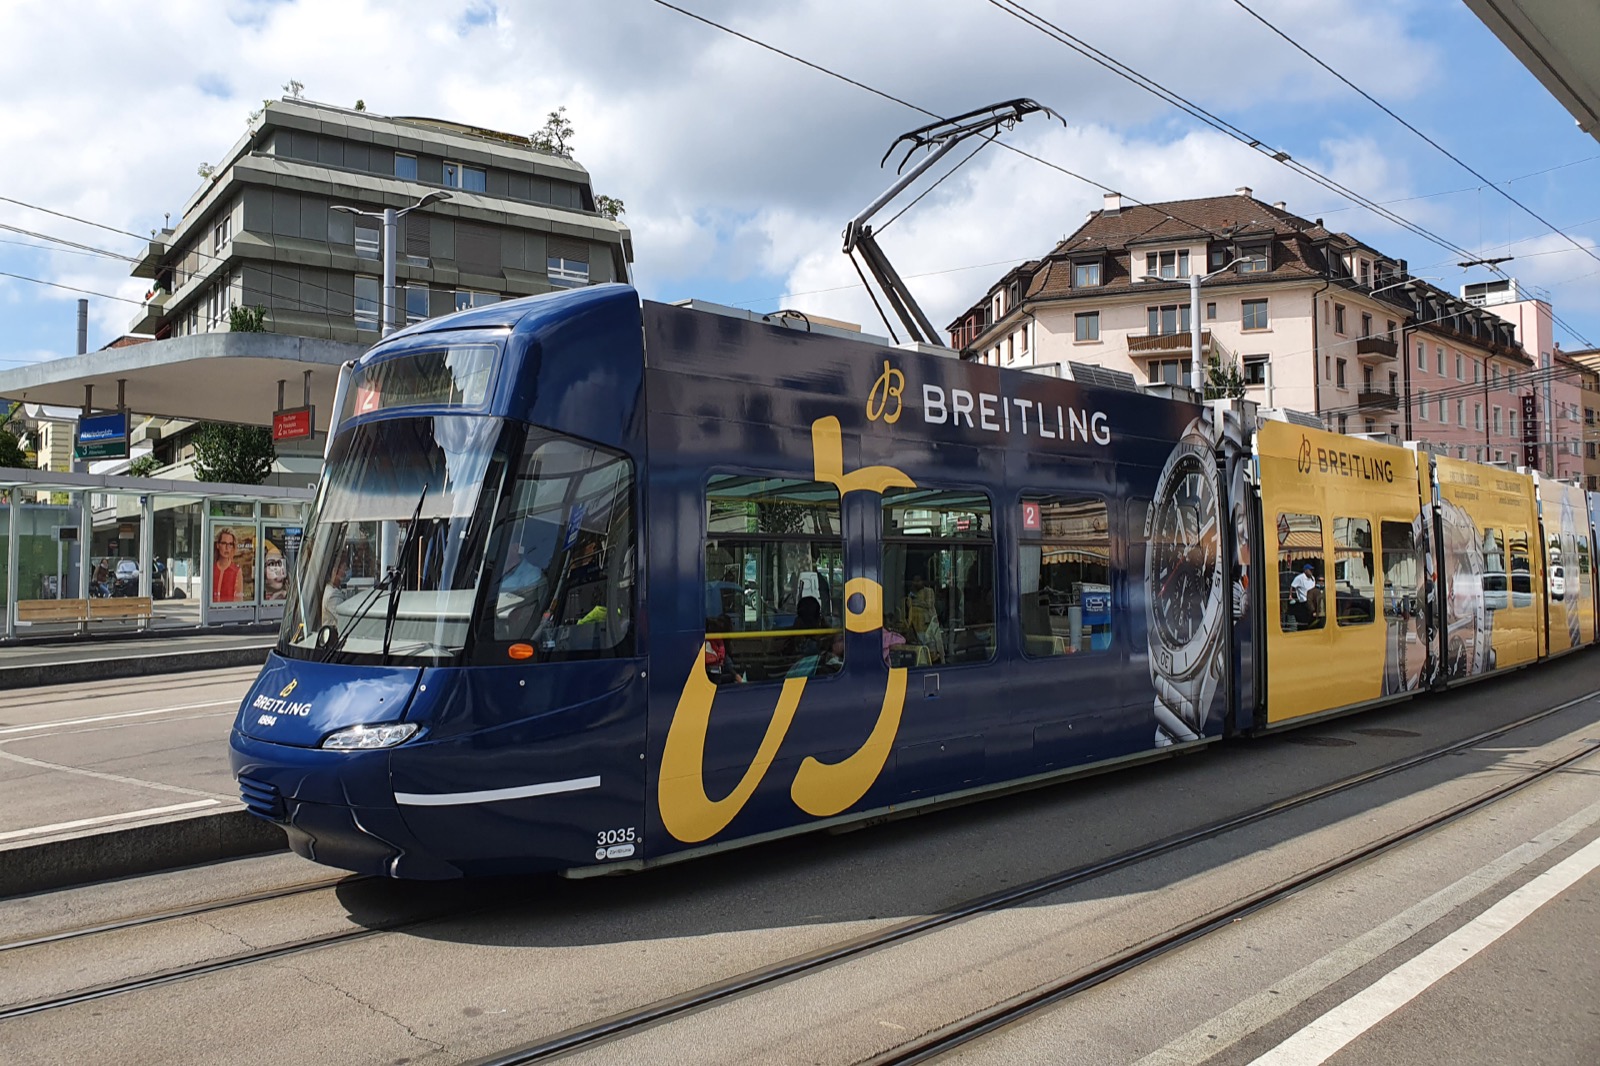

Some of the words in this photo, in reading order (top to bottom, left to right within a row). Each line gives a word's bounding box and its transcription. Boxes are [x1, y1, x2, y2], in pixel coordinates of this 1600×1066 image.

[922, 383, 1111, 447] BREITLING
[1525, 399, 1533, 436] HOTEL
[277, 423, 283, 436] 2
[82, 445, 88, 456] 3
[1317, 447, 1395, 483] BREITLING
[1026, 506, 1035, 525] 2
[252, 694, 312, 717] BREITLING
[257, 715, 277, 726] 1884
[597, 827, 635, 845] 3035
